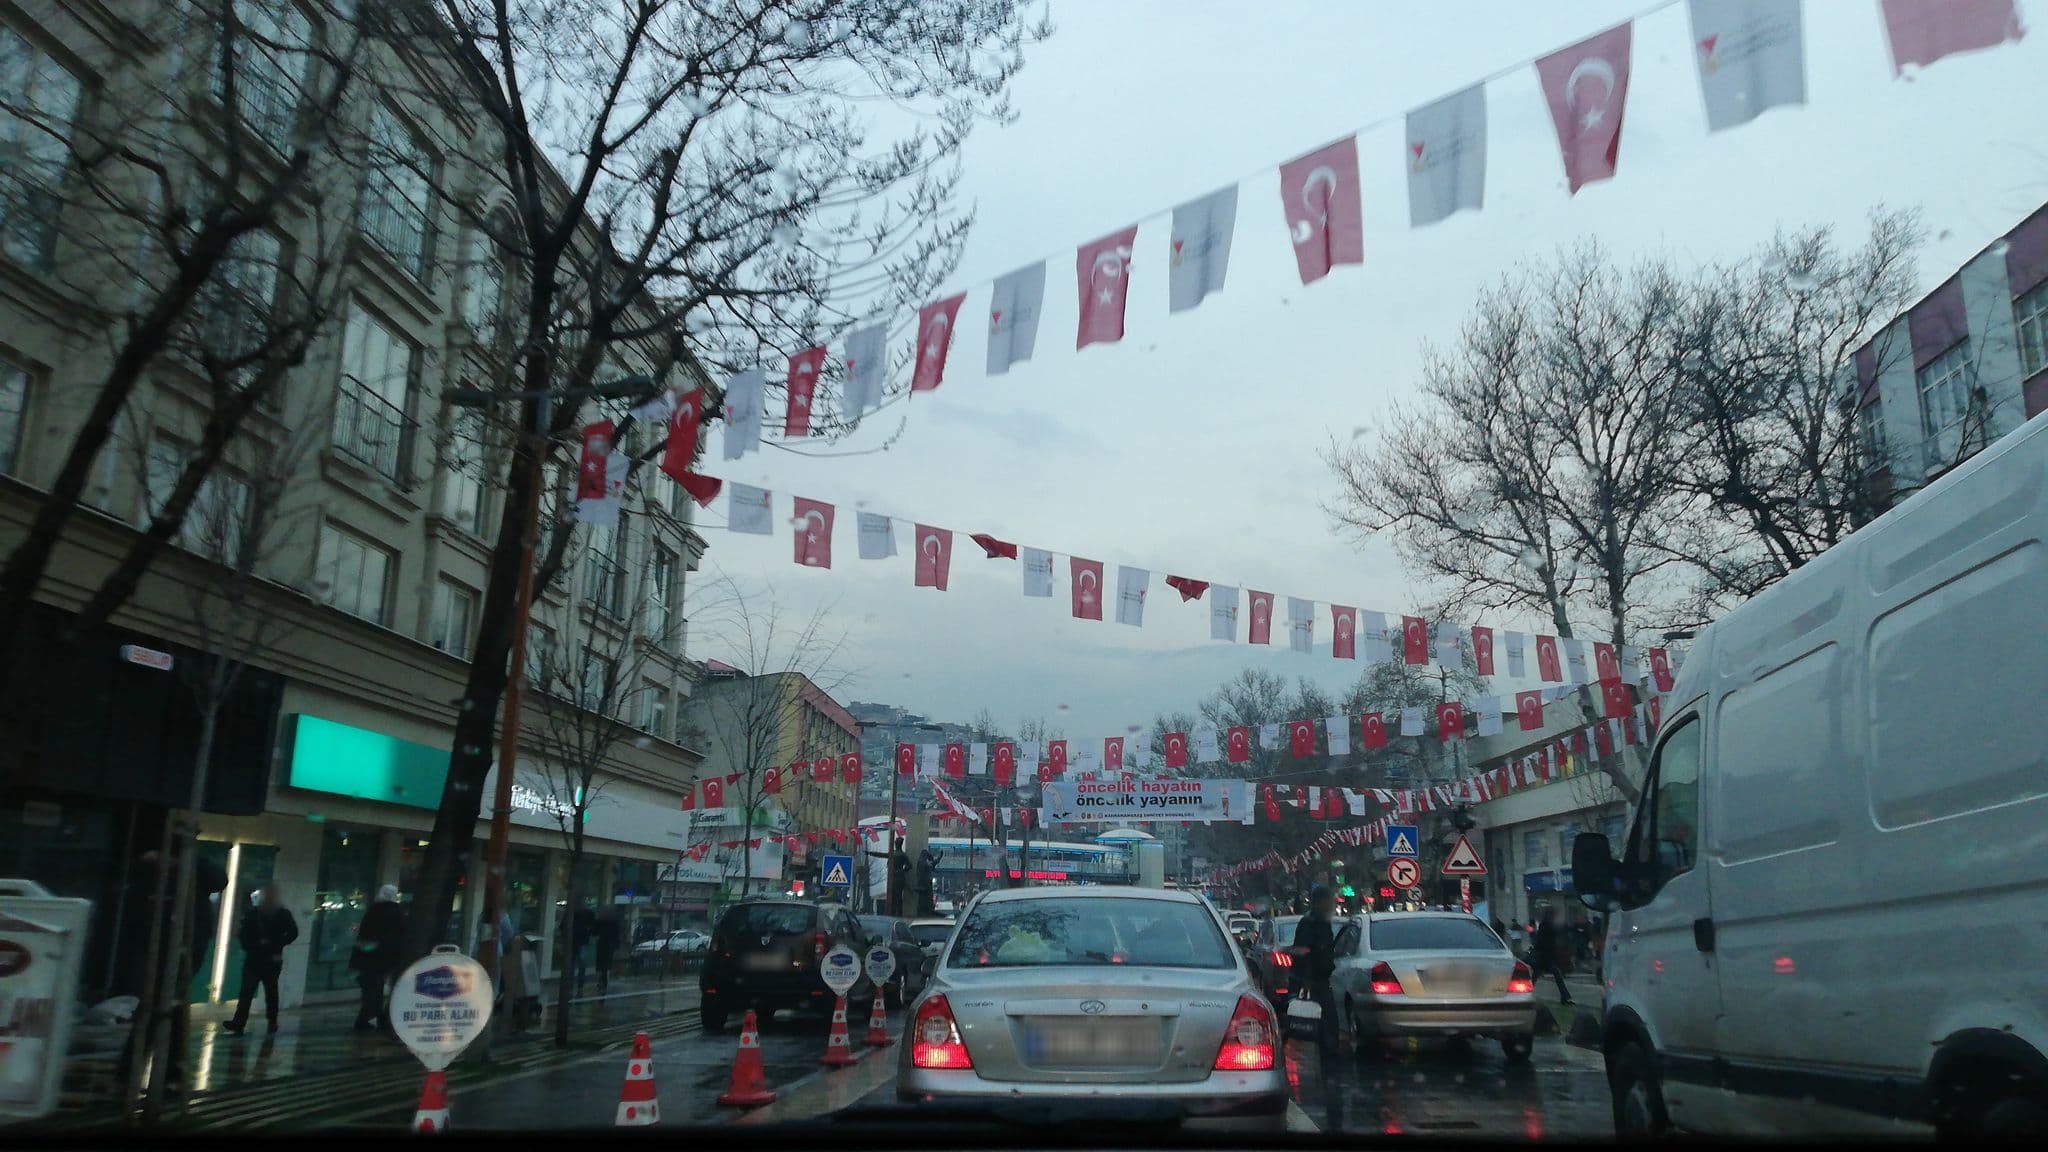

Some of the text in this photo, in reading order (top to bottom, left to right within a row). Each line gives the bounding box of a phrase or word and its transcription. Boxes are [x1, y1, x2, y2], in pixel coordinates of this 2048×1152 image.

[1077, 780, 1202, 796] öncelik hayatın
[1140, 796, 1203, 808] yayanın
